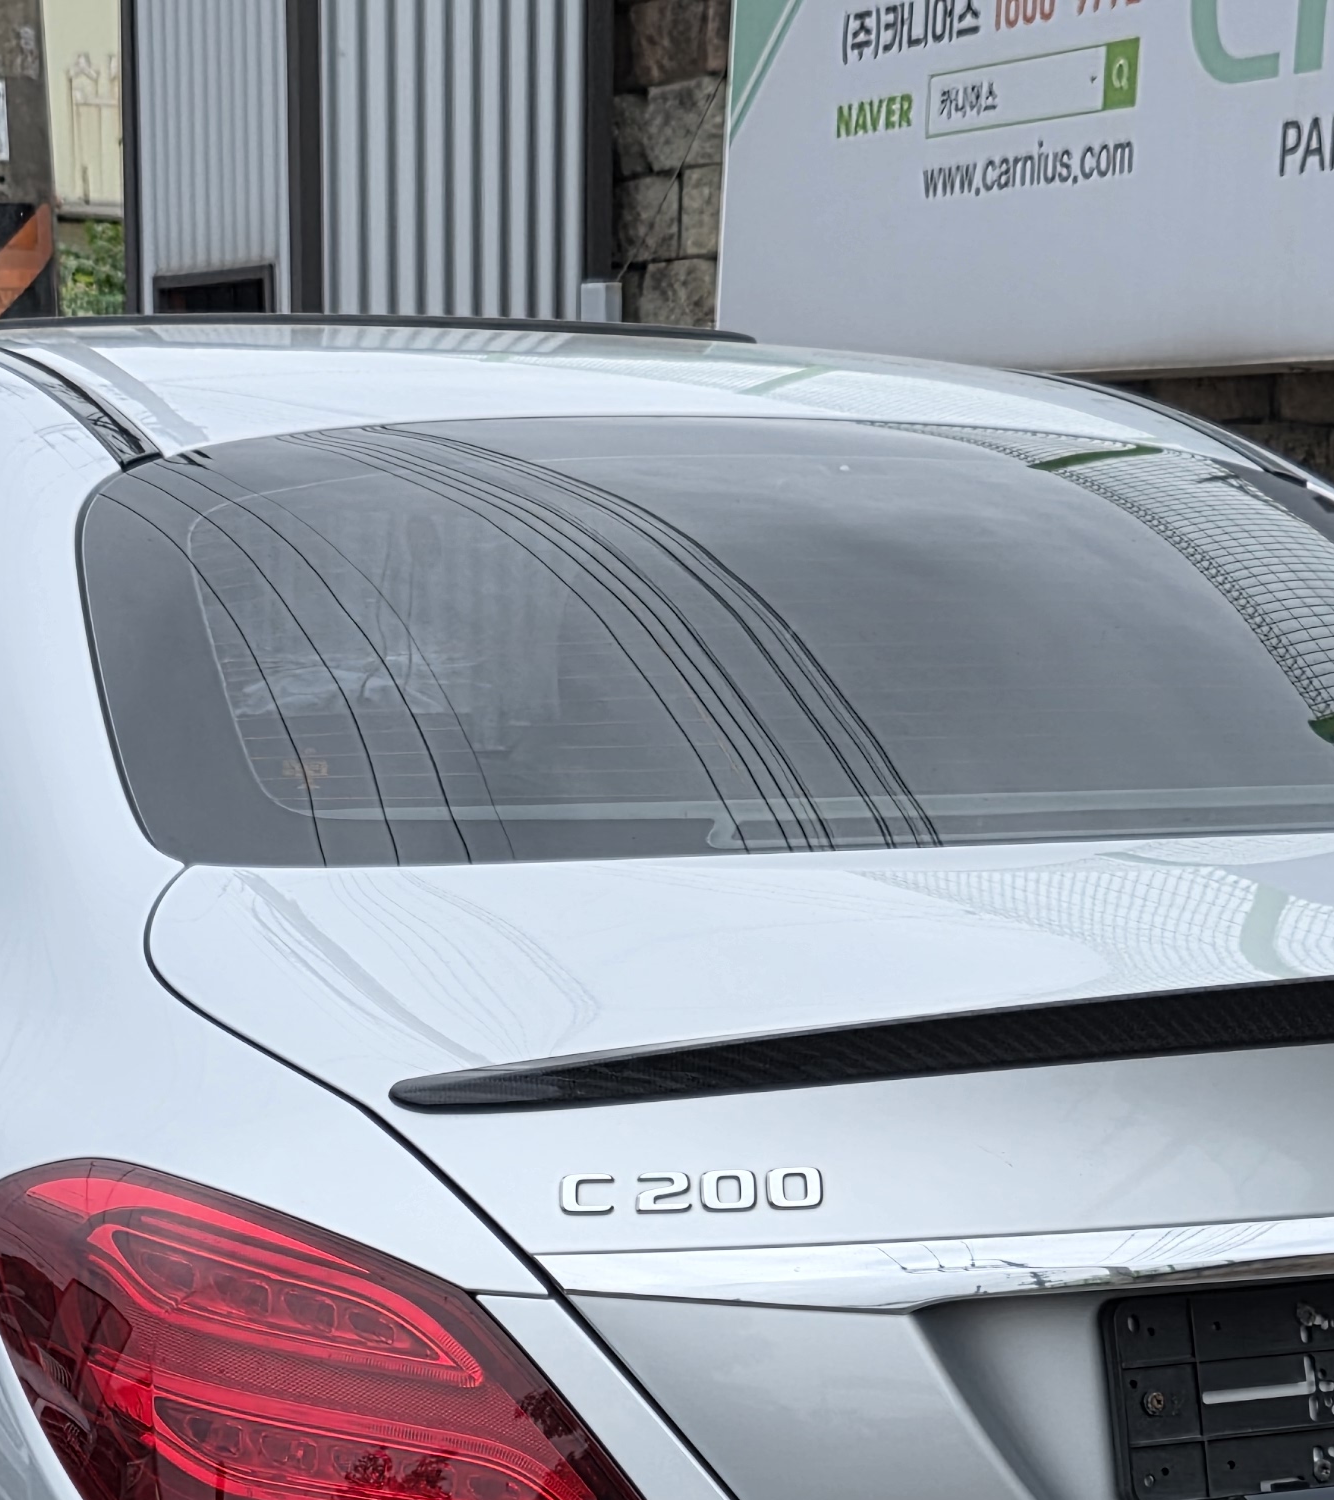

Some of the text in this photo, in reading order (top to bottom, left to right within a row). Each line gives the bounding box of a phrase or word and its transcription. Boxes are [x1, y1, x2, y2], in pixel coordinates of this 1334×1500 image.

[837, 94, 913, 138] NAVER
[923, 140, 1134, 199] www.carnius.com
[559, 1167, 824, 1215] C 200
